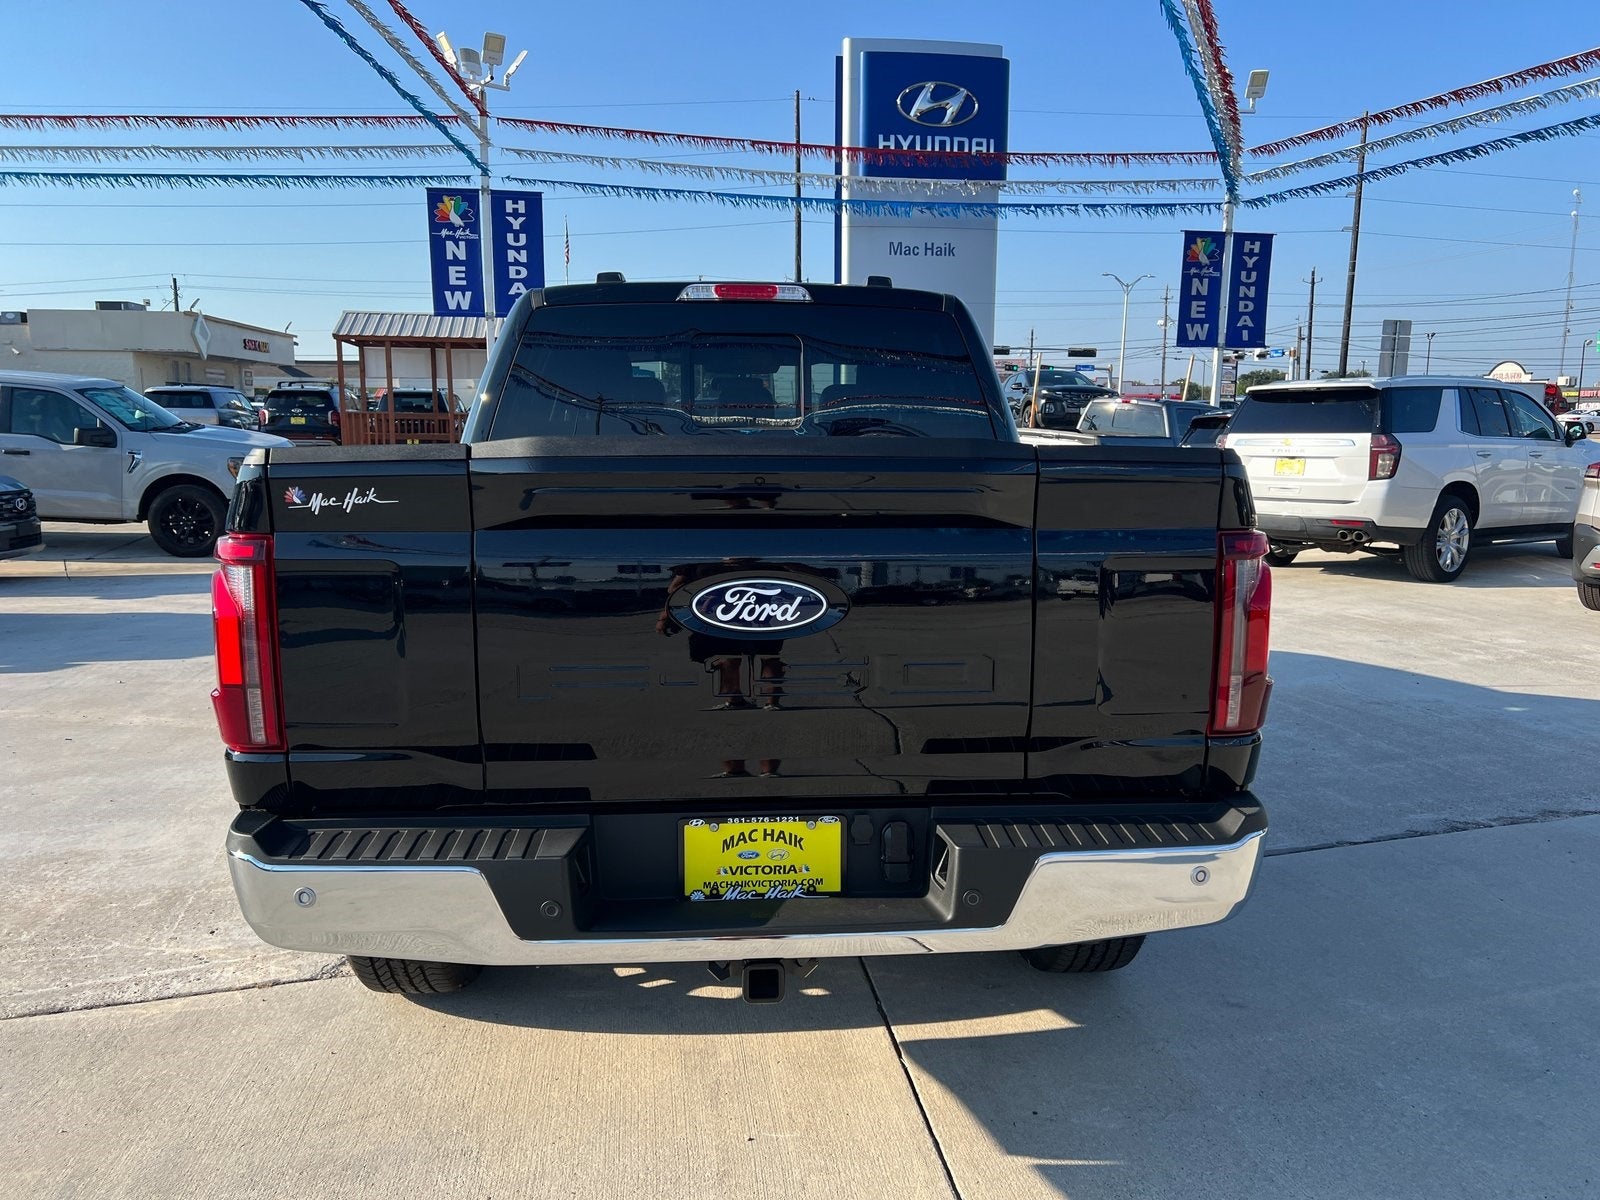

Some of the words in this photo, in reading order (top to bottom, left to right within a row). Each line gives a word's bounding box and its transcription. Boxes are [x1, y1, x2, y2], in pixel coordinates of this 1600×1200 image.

[878, 133, 995, 154] HYUNDAI
[505, 199, 528, 301] HYUNDA
[888, 241, 920, 256] Mac
[924, 242, 956, 257] Haik
[444, 240, 472, 310] NEW
[1236, 240, 1261, 341] HYUNDAI
[1185, 278, 1210, 341] NEW
[298, 492, 342, 515] Mac
[342, 487, 388, 514] Haik
[716, 587, 803, 622] Ford
[727, 816, 800, 824] 361-576-1221
[721, 828, 759, 854] MAC
[763, 828, 804, 851] HAIK
[729, 864, 798, 876] VICTORIA
[702, 878, 824, 890] MACHAIKVICTORIA.COM
[717, 885, 762, 900] Mac
[763, 884, 812, 899] Haik
